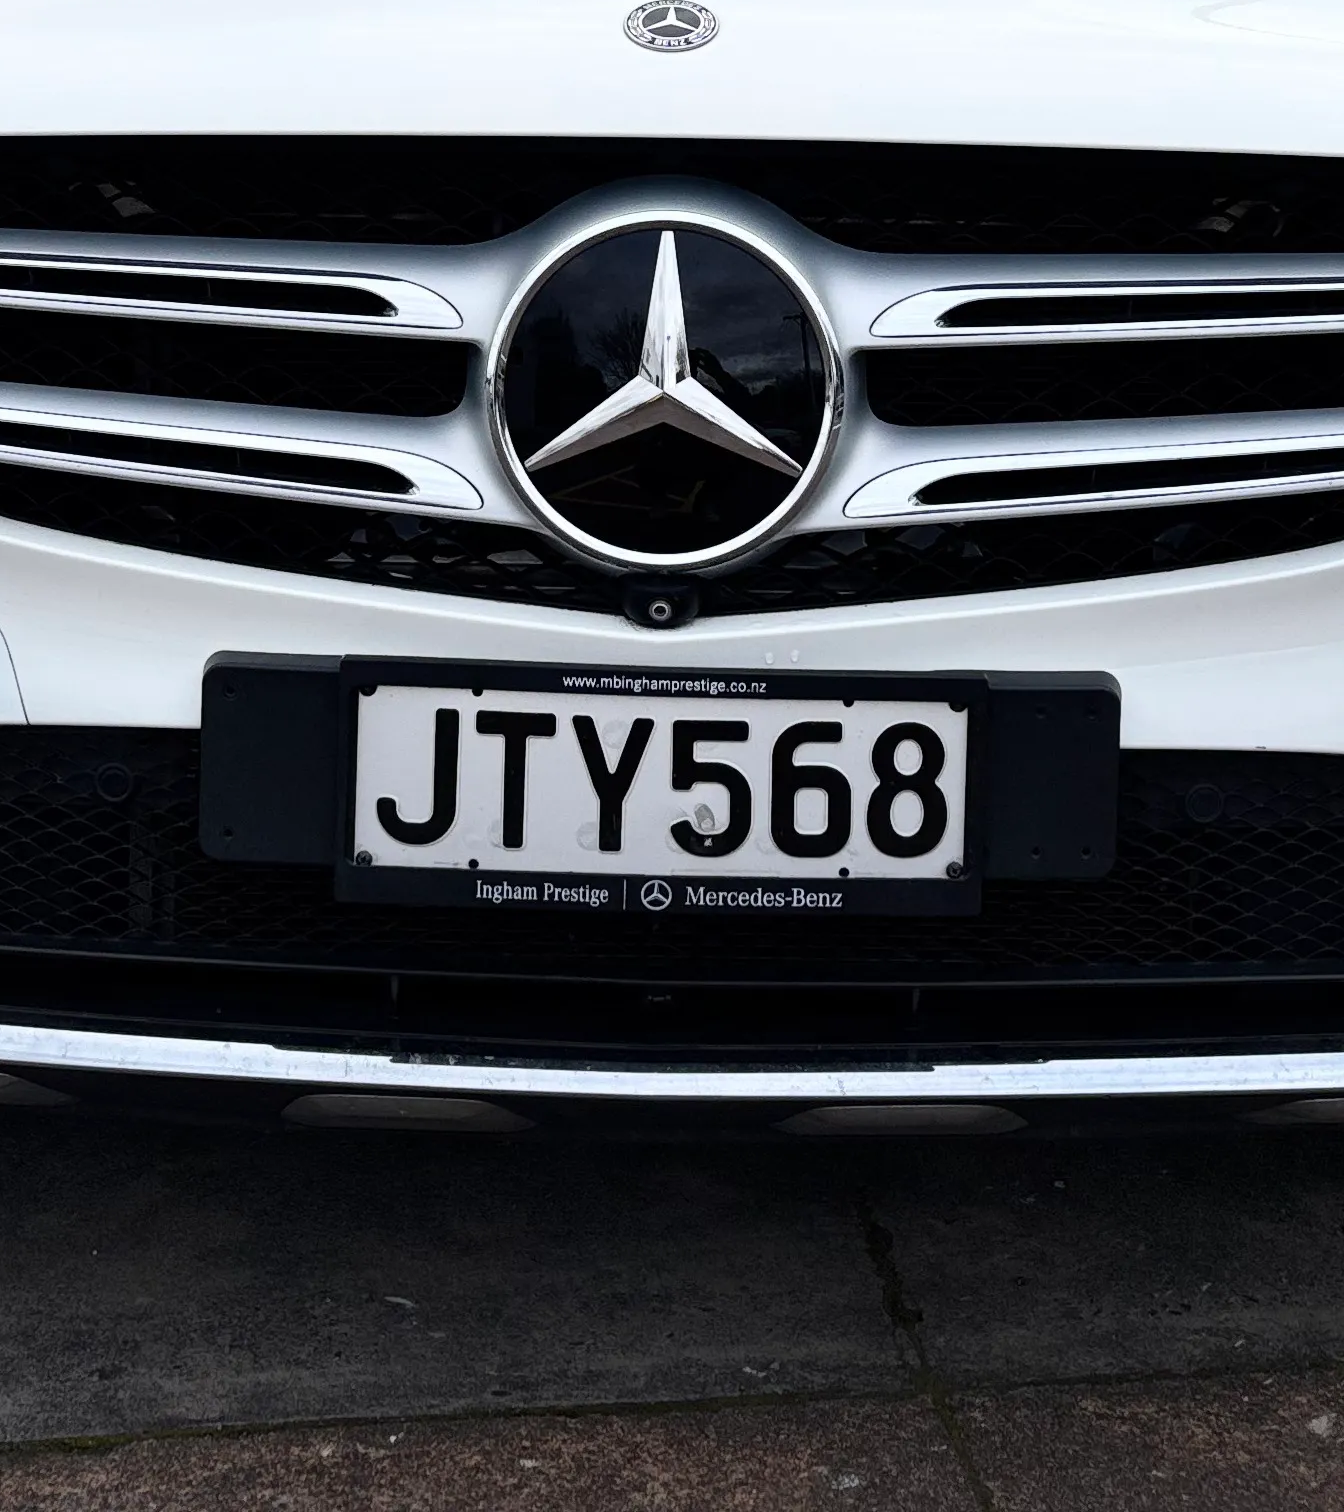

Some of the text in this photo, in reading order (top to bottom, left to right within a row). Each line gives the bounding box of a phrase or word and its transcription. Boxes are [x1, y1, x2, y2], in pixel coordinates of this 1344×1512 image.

[562, 674, 767, 695] www.mbinghamprestige.co.nz
[376, 707, 949, 859] JTY568
[475, 879, 844, 908] Ingham Prestige Mercedes-Benz
